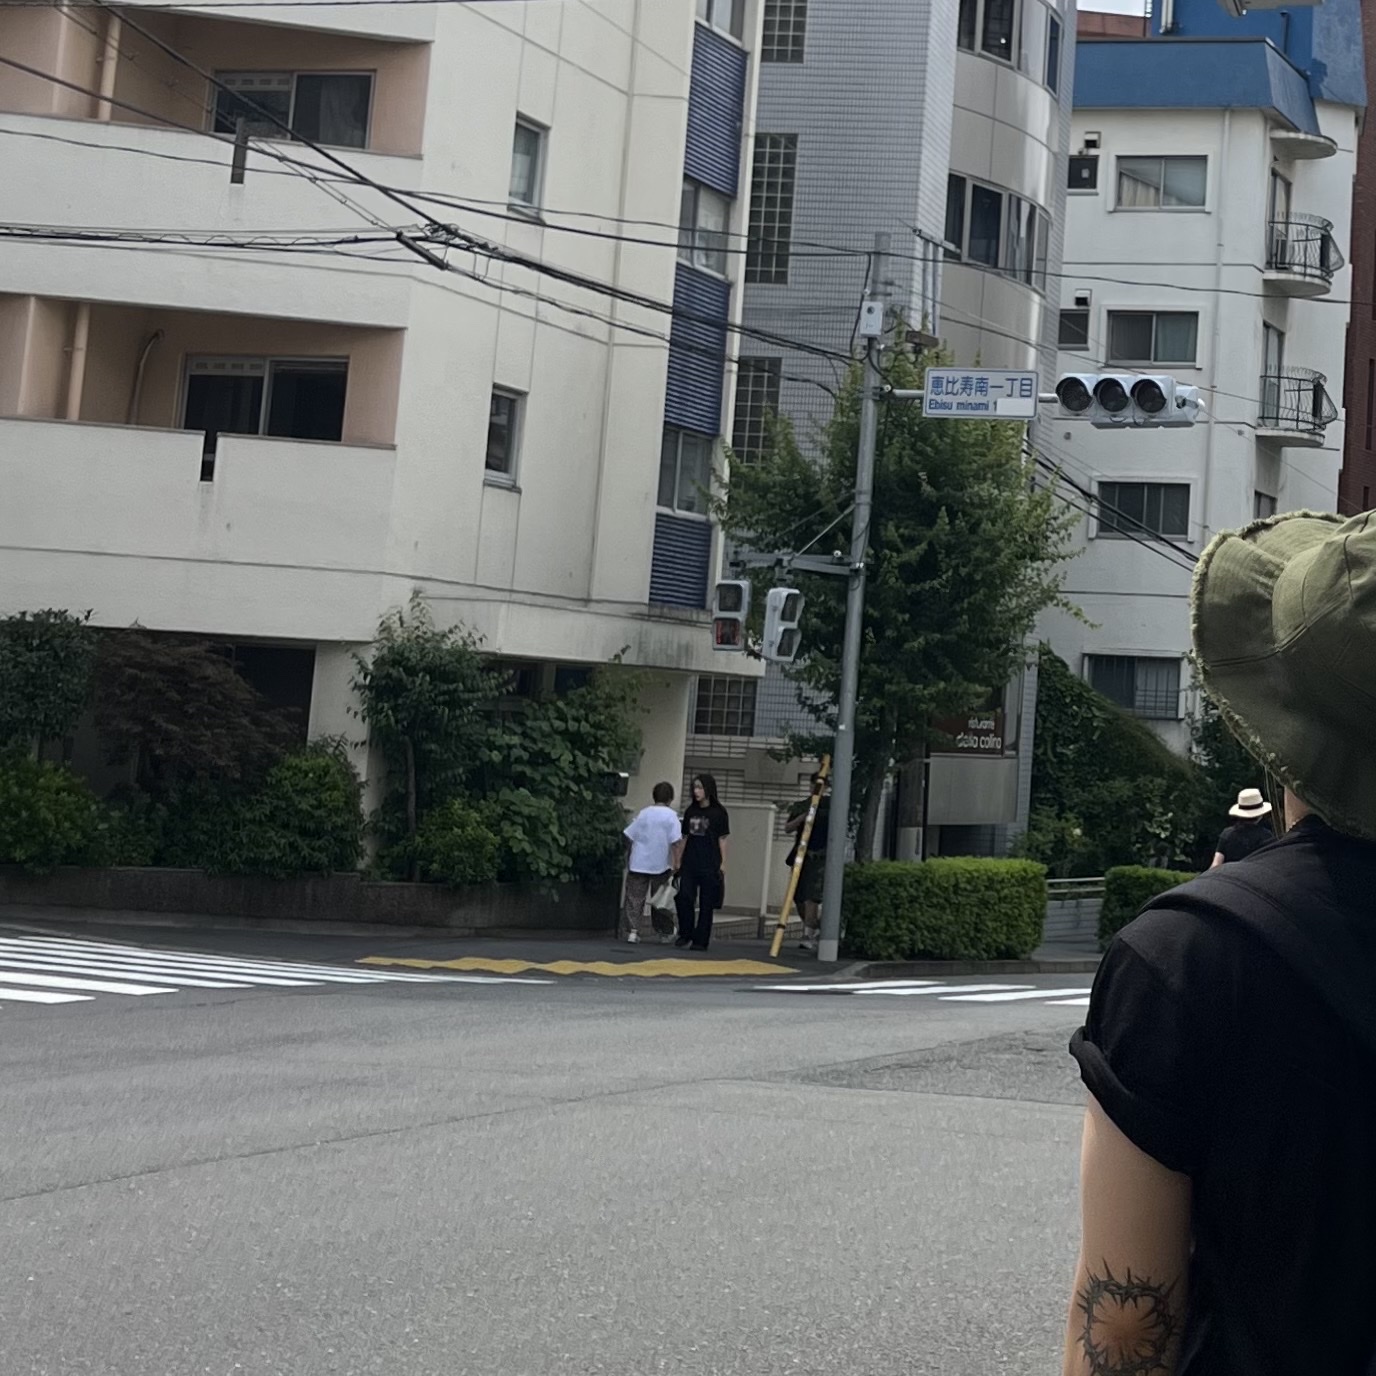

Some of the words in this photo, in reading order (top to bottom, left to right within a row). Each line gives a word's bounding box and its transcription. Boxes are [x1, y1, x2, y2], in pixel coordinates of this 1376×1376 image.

[930, 375, 1033, 398] 恵比寿南一丁目
[928, 398, 953, 410] Ebisu
[956, 399, 989, 411] minami
